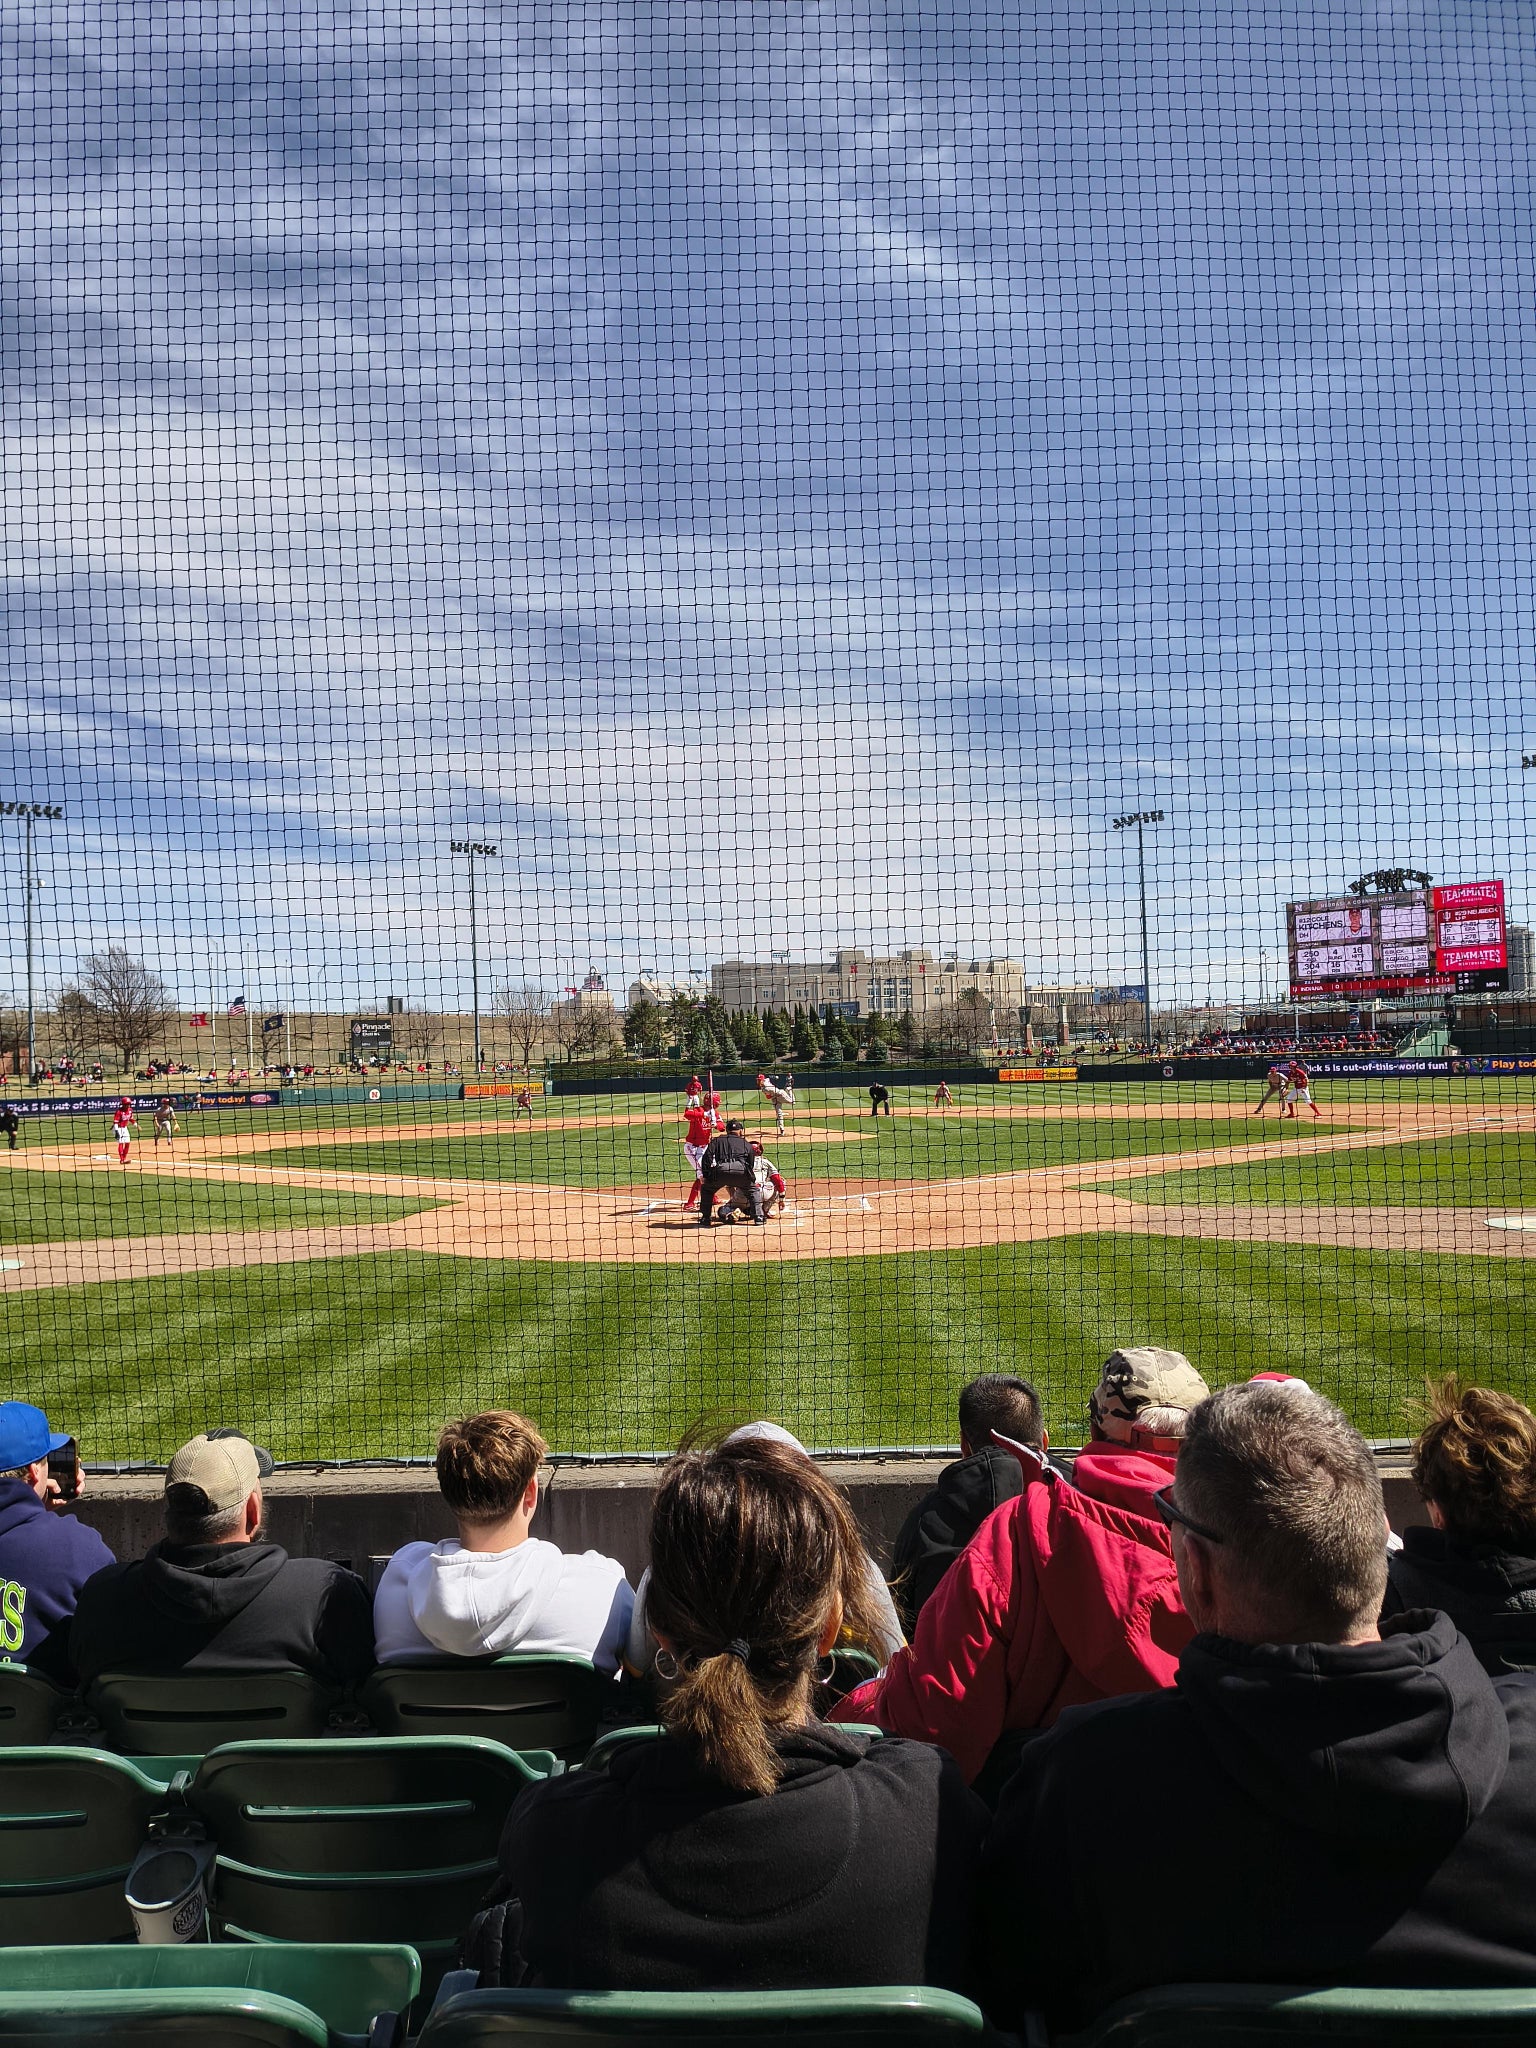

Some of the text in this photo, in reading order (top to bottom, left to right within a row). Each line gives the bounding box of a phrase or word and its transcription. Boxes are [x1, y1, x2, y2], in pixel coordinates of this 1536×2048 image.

[1441, 885, 1497, 904] TEAMMATES
[1321, 900, 1351, 908] NEBRASA
[1311, 915, 1329, 923] COLE
[1298, 920, 1343, 931] KITCHENS
[1443, 949, 1501, 967] TEAMMATES
[1308, 1061, 1449, 1072] ick 5 is out-of-this-world fun!
[1492, 1060, 1516, 1070] Play
[371, 1091, 379, 1099] N
[200, 1096, 215, 1105] lay
[31, 1103, 38, 1111] 5
[40, 1102, 49, 1111] is
